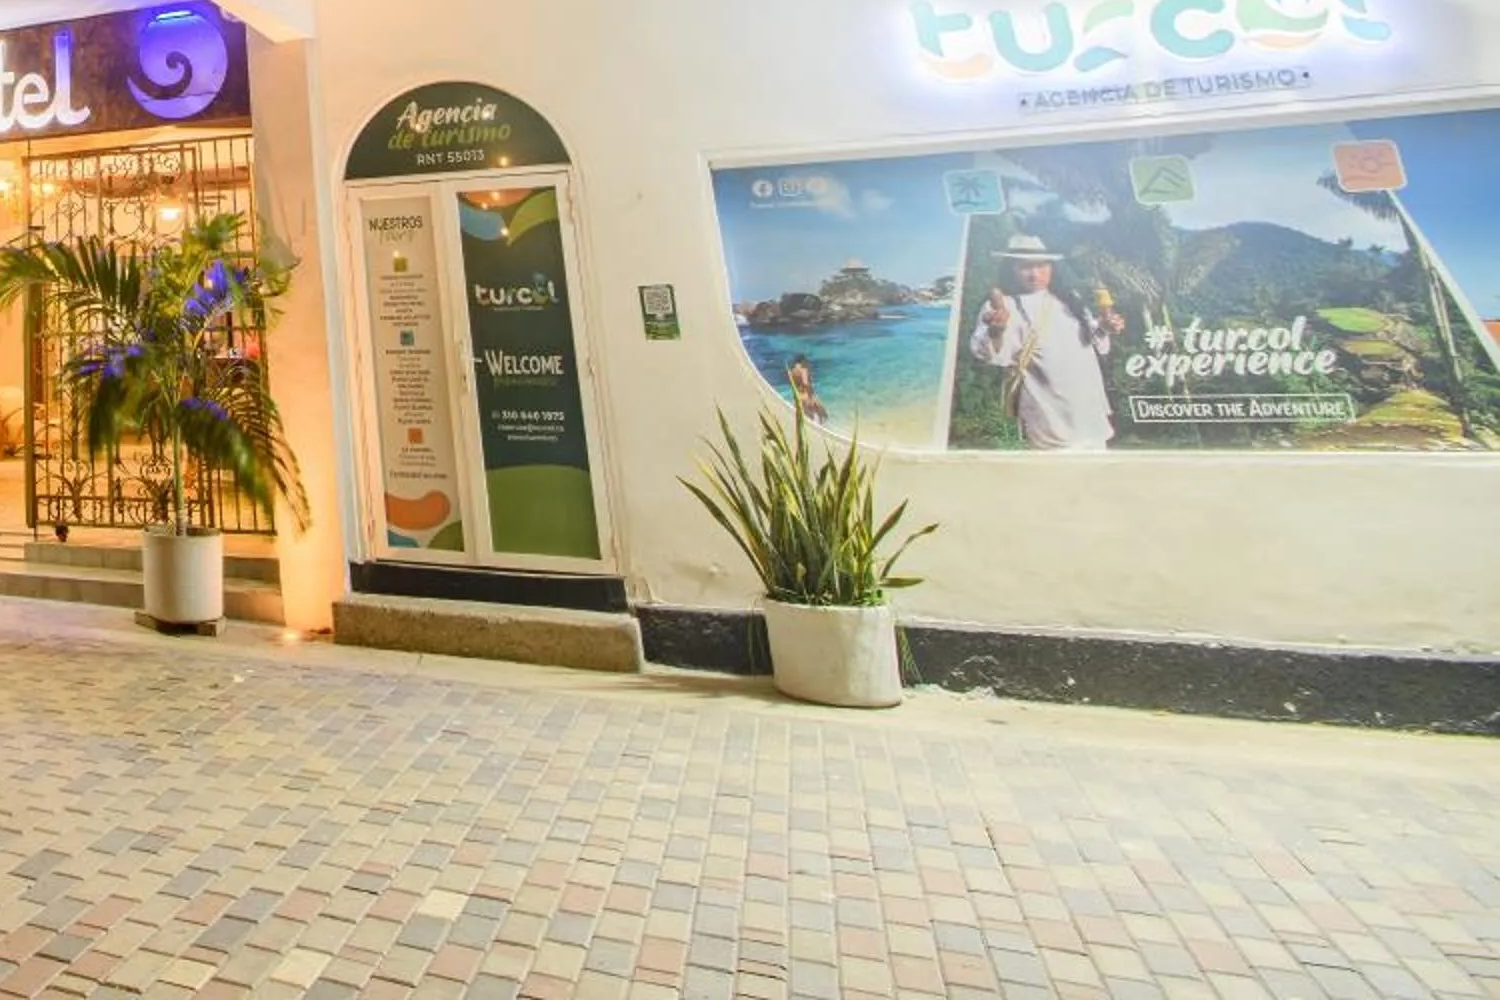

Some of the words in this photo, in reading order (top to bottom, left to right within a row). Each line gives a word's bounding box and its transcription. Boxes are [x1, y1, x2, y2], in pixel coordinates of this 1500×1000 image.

[1034, 84, 1137, 108] AGENCIA
[1146, 79, 1178, 99] DE
[1185, 69, 1296, 95] TURISMO
[395, 97, 498, 133] Agencia
[387, 128, 414, 150] de
[419, 123, 512, 149] turismo
[417, 152, 443, 166] RNT
[368, 215, 423, 232] NUESTROS
[484, 350, 565, 378] WELCOME
[1125, 349, 1337, 387] experience
[1137, 400, 1213, 418] DISCOVER
[1215, 402, 1245, 417] THE
[1250, 399, 1346, 418] ADVENTURE
